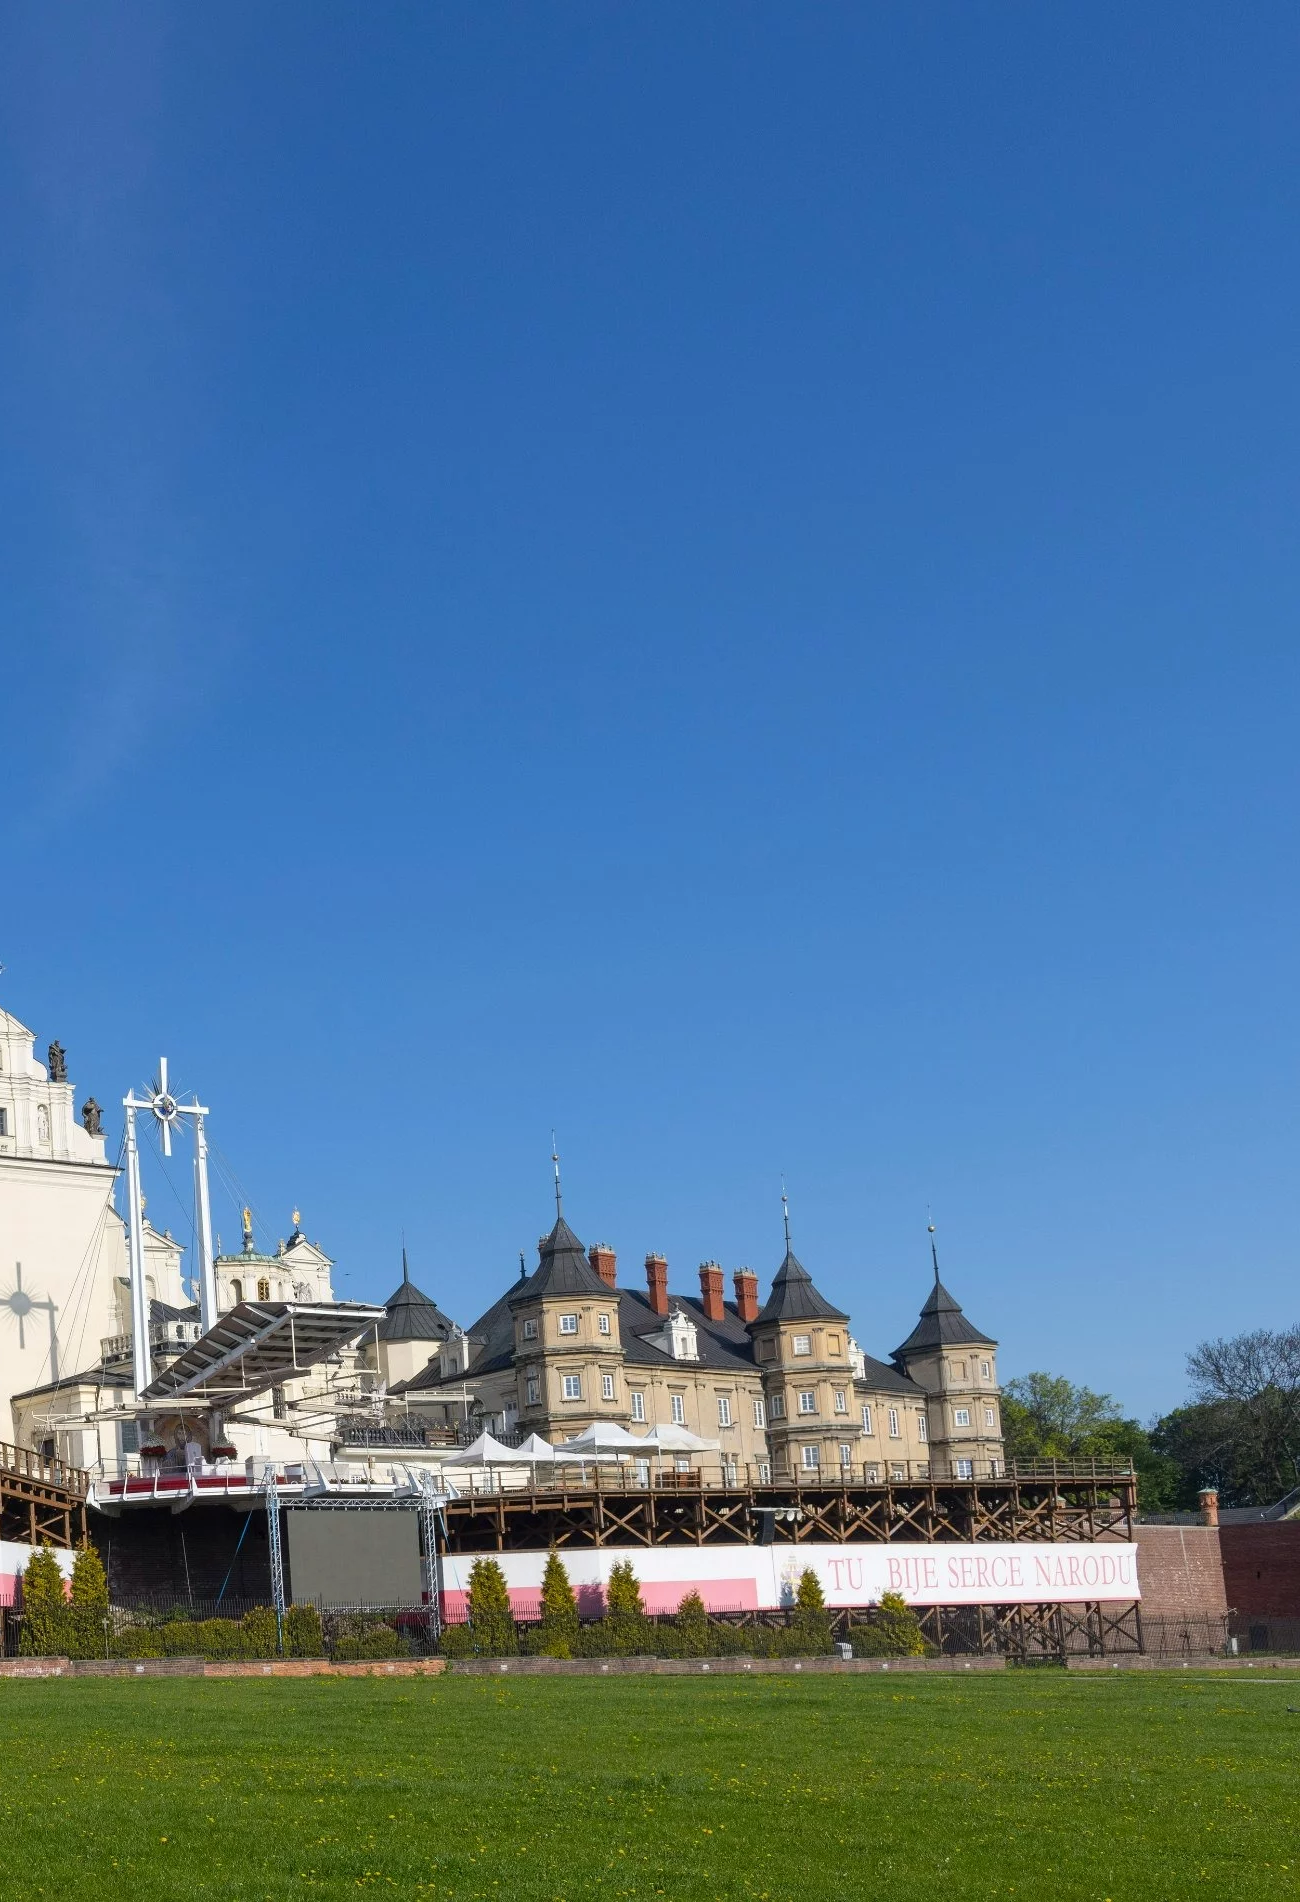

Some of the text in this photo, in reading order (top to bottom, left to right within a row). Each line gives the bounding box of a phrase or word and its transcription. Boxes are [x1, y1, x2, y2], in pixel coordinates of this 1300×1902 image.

[827, 1558, 863, 1591] TU
[947, 1556, 1024, 1588] SERCE
[1033, 1554, 1131, 1587] NARODU
